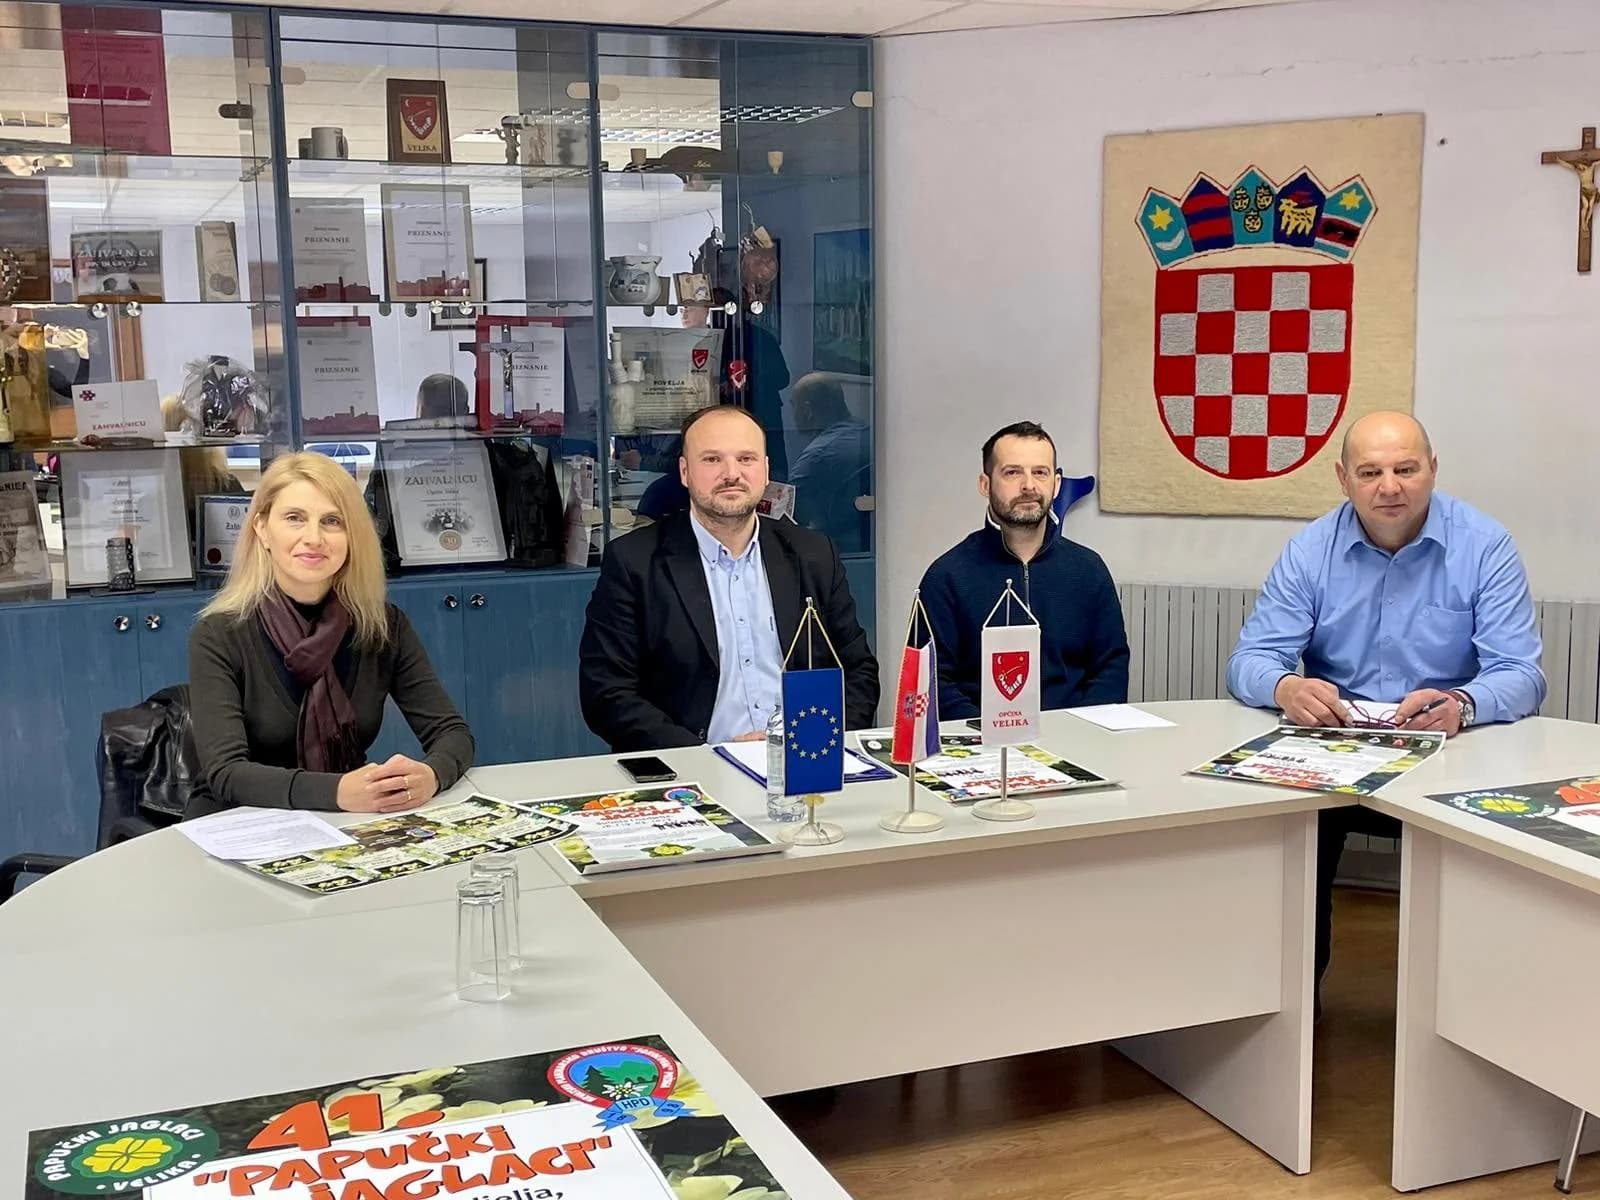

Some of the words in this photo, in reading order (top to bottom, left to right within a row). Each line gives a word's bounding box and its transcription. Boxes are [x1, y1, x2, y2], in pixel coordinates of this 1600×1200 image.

[92, 421, 146, 430] ZAHVALNICU
[404, 475, 478, 485] ZAHVALNICU
[992, 719, 1029, 728] VELIKA
[621, 1098, 650, 1109] HPD
[247, 1093, 445, 1151] 41.
[43, 1129, 103, 1181] PAPUČKI
[108, 1120, 206, 1141] JAGLACI
[112, 1160, 198, 1191] VELIKA
